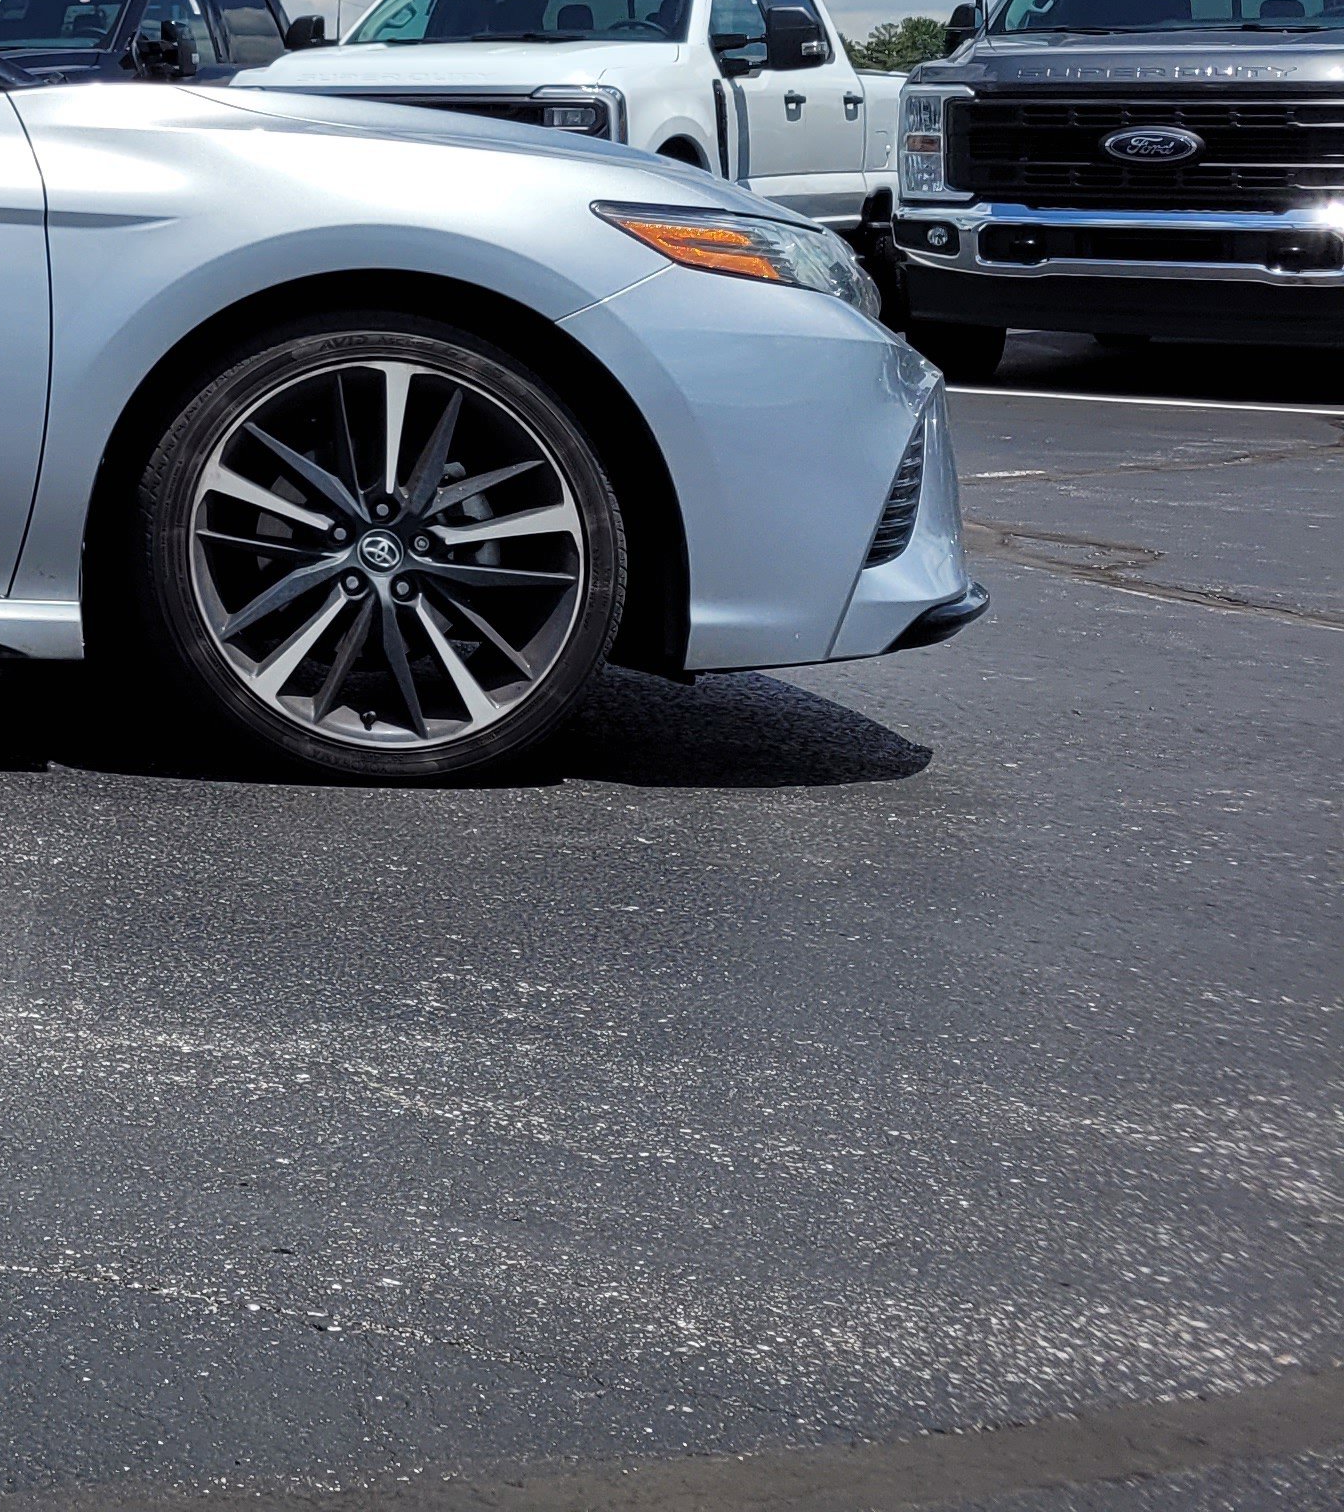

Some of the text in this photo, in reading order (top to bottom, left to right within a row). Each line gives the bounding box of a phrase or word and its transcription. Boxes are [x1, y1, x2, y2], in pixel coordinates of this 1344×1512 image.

[296, 71, 497, 82] SUPER DUTY
[1017, 65, 1299, 79] SUPER DUTY
[1126, 136, 1174, 156] Ford
